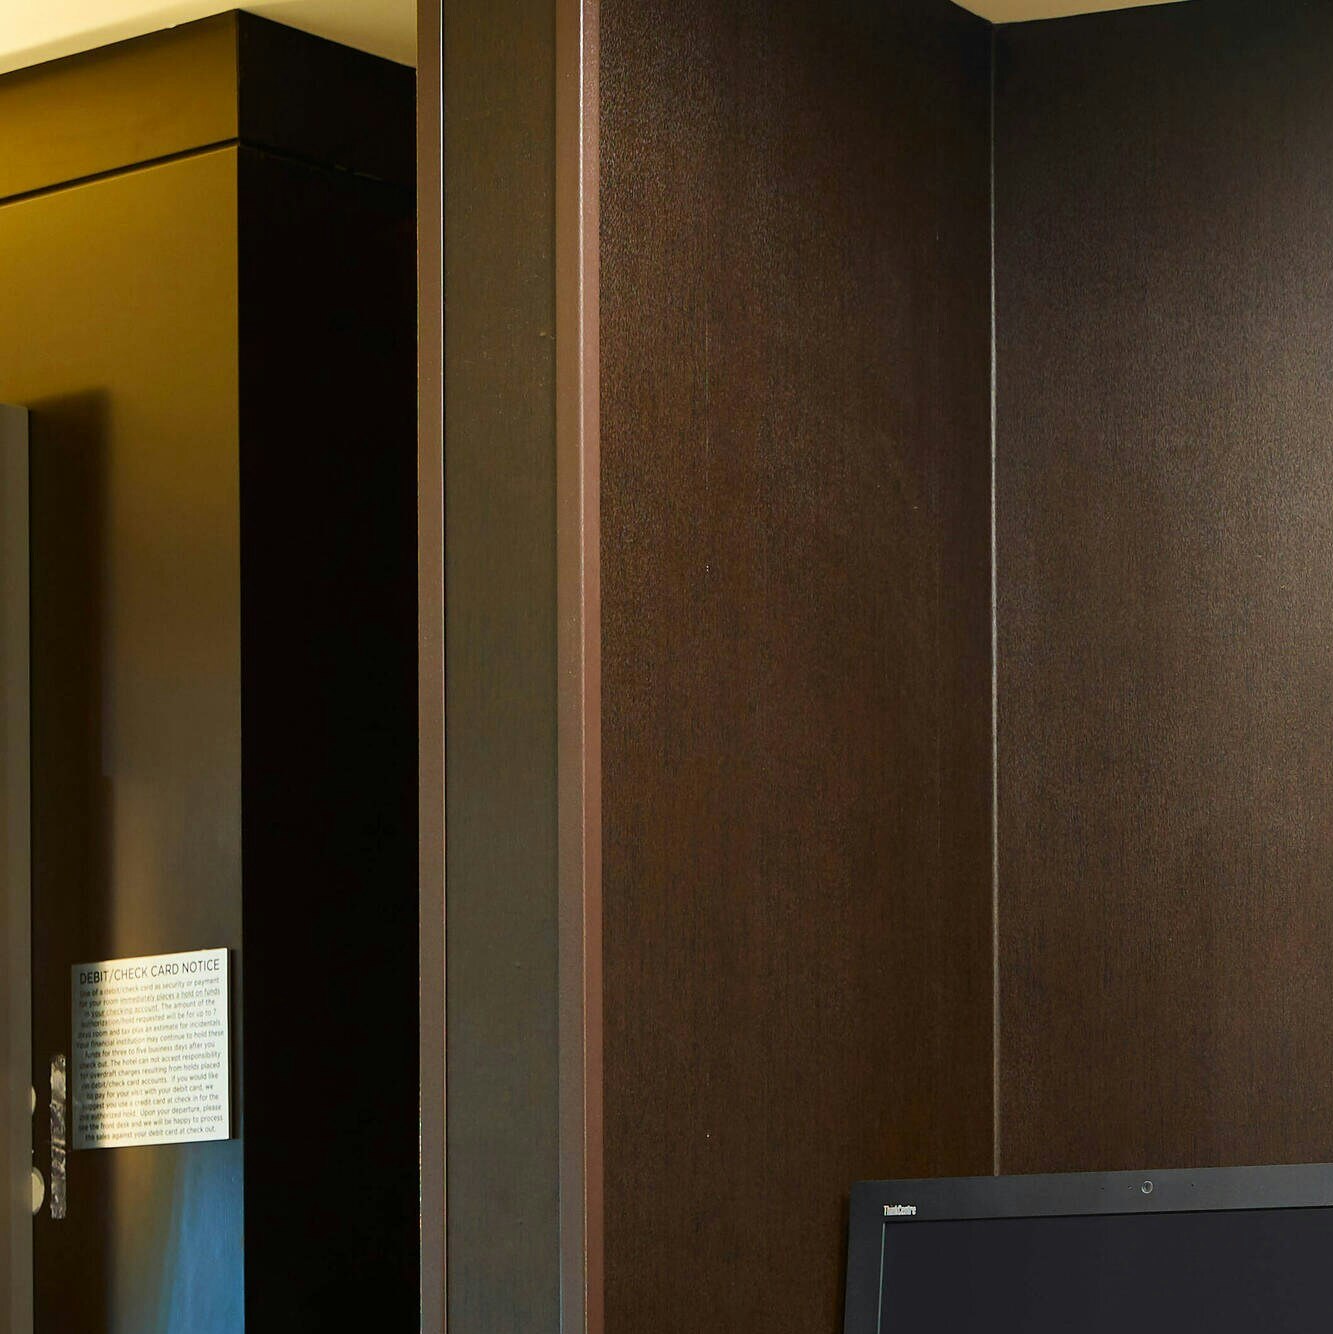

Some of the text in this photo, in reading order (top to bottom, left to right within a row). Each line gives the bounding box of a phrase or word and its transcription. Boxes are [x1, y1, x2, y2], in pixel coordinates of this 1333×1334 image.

[79, 958, 219, 985] DEBIT/CHECK CARD NOTICE
